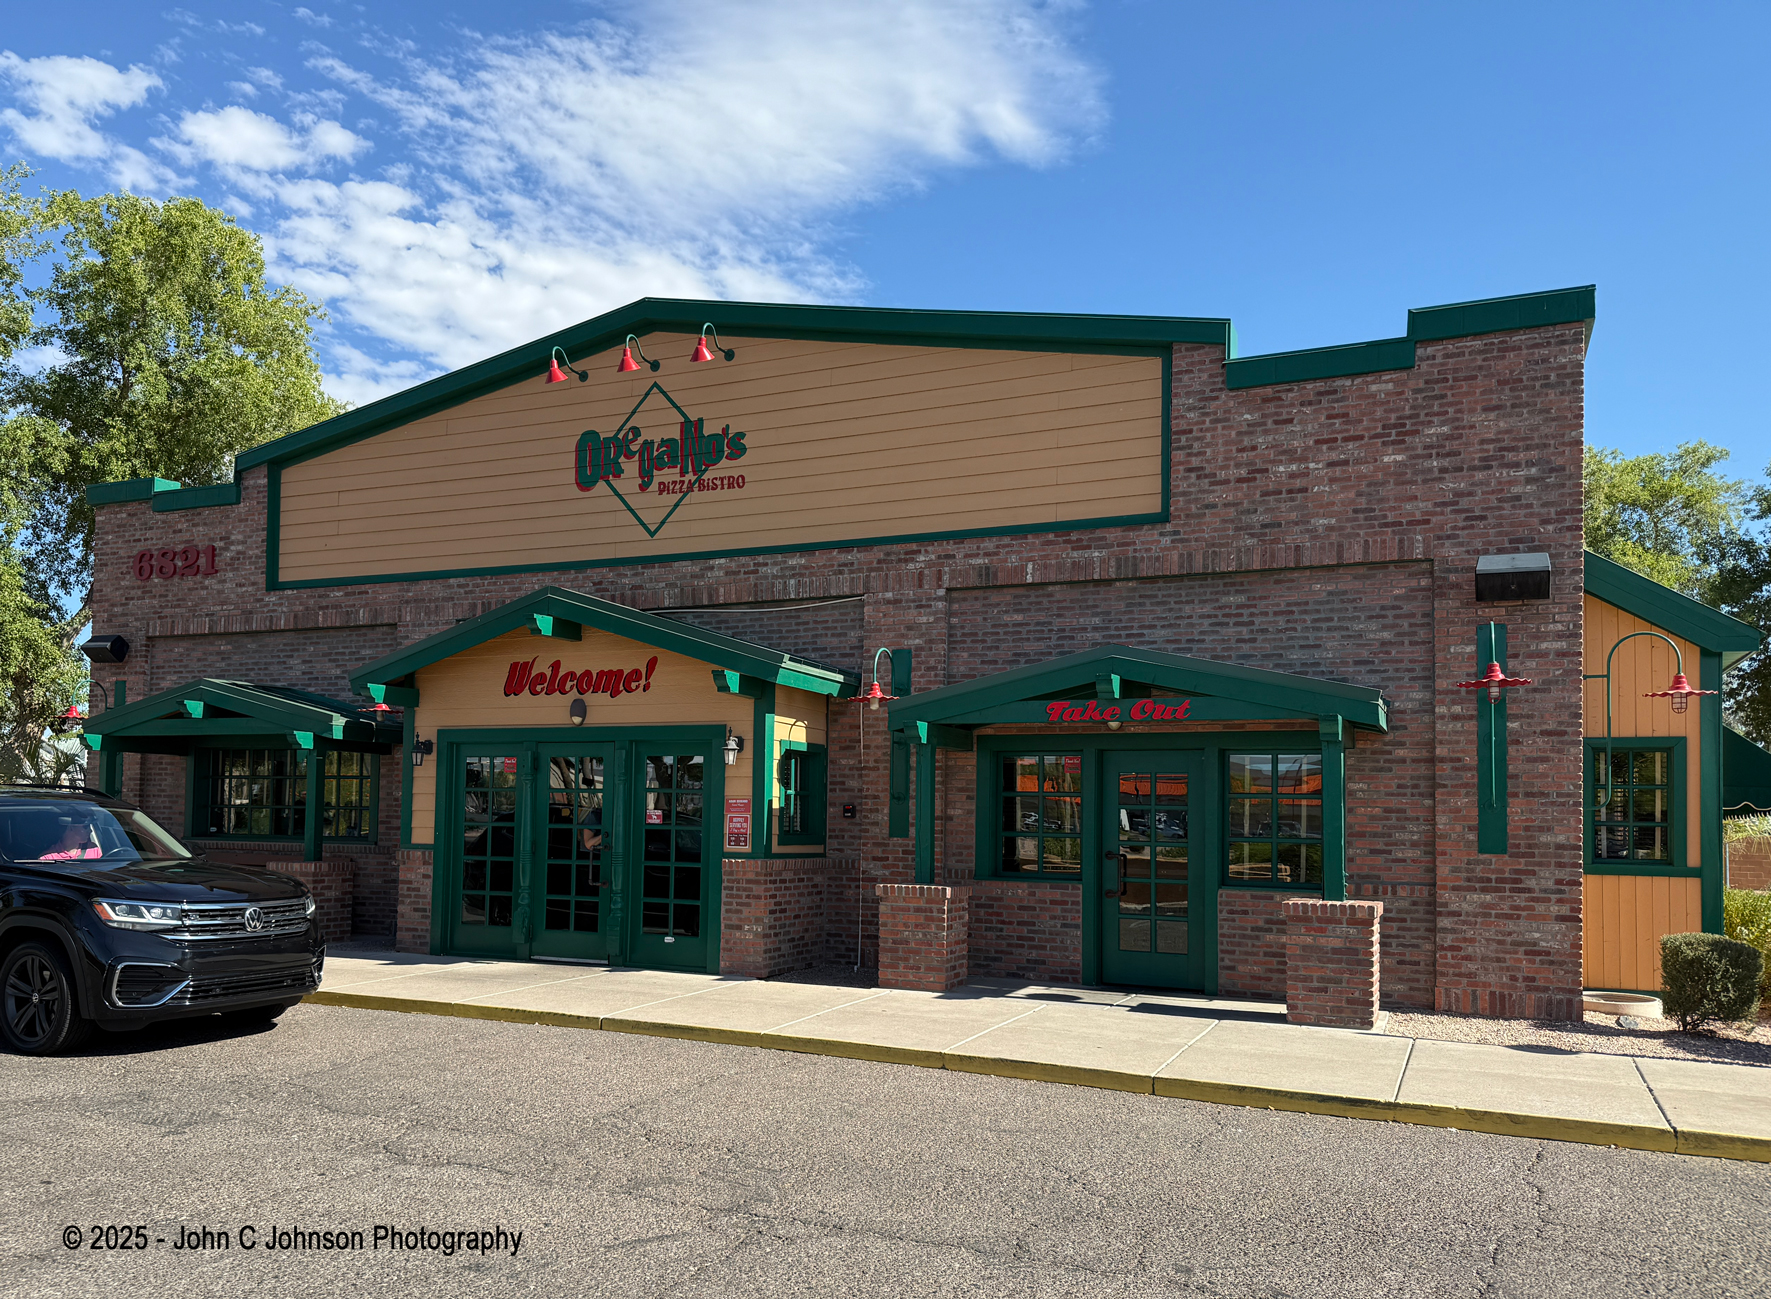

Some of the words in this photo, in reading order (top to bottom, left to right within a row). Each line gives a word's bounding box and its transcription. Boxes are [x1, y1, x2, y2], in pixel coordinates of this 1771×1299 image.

[133, 545, 218, 580] 6821
[503, 655, 658, 698] Welcome!
[1046, 700, 1121, 722] Take
[1130, 700, 1191, 720] Out
